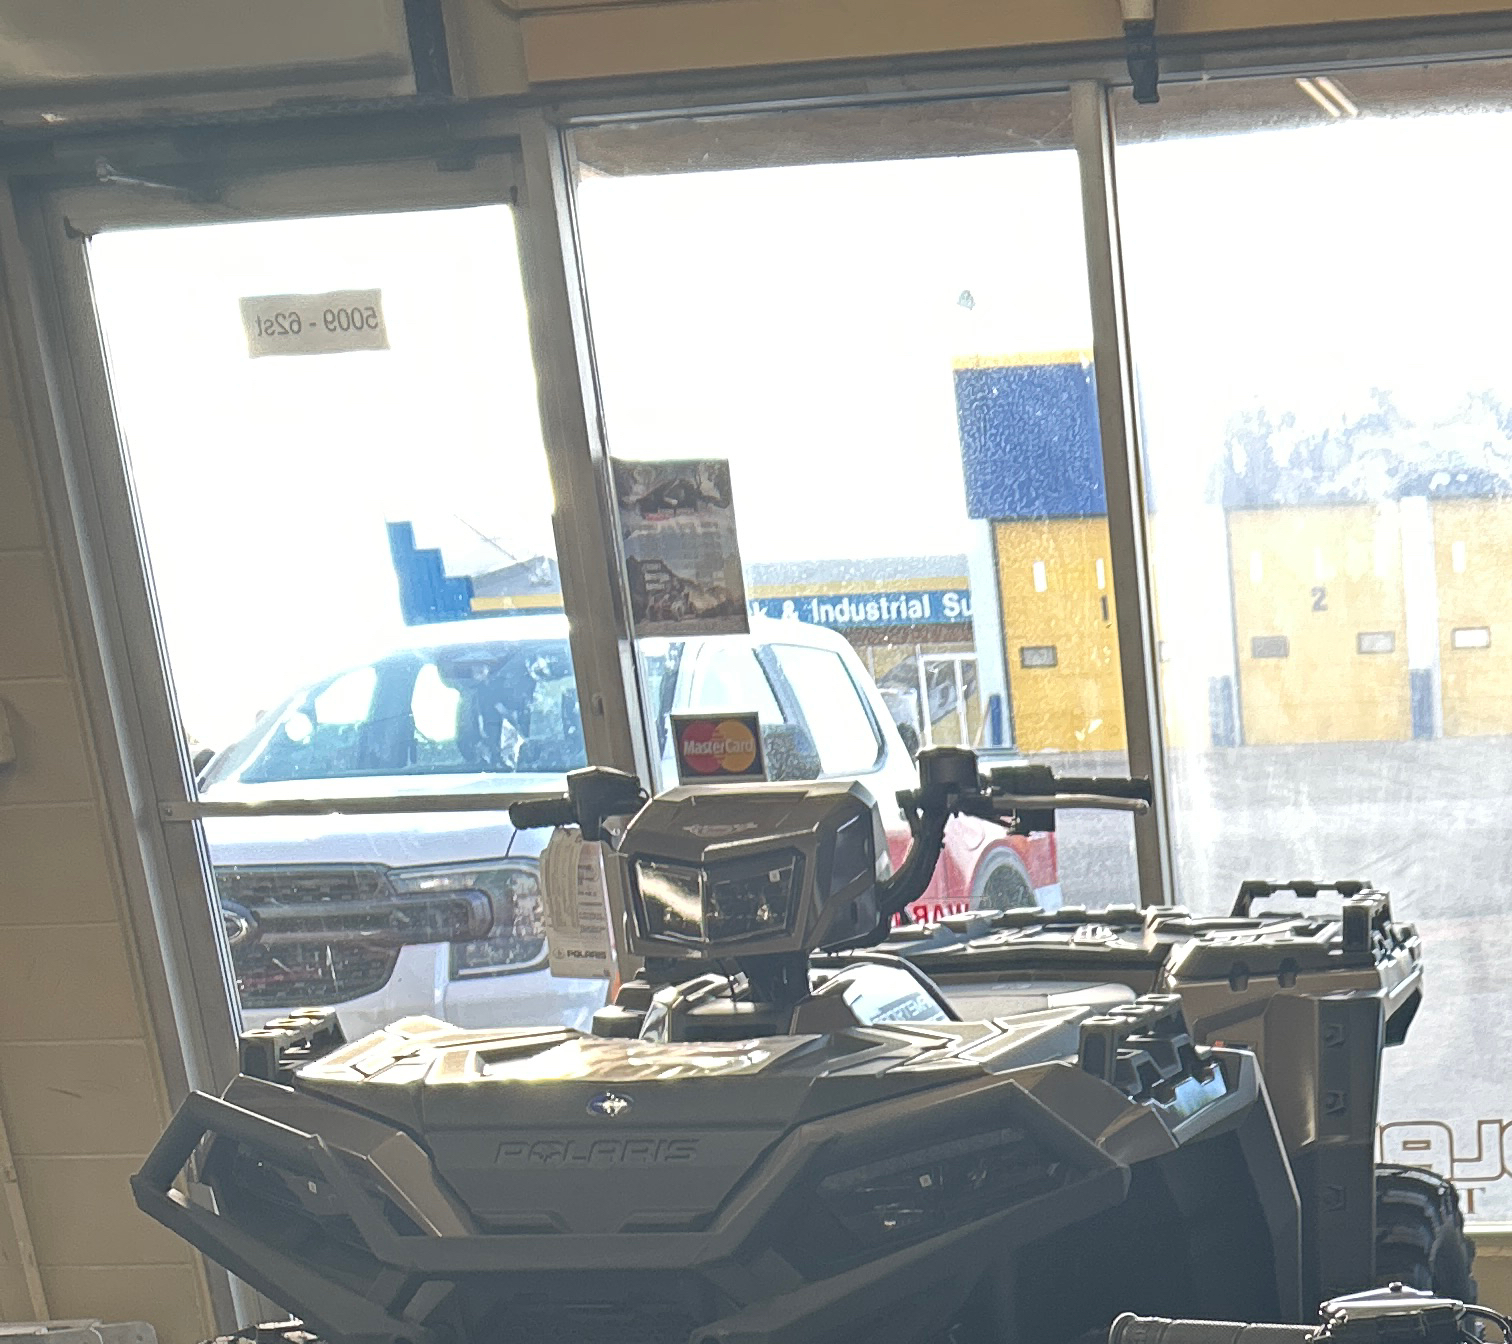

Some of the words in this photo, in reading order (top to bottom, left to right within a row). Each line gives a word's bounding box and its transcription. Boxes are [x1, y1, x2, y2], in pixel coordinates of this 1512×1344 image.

[812, 593, 930, 623] Industrial
[1311, 586, 1329, 612] 2
[683, 739, 754, 758] MasterCard
[567, 950, 607, 961] POLARIS
[494, 1138, 700, 1164] POLARIS
